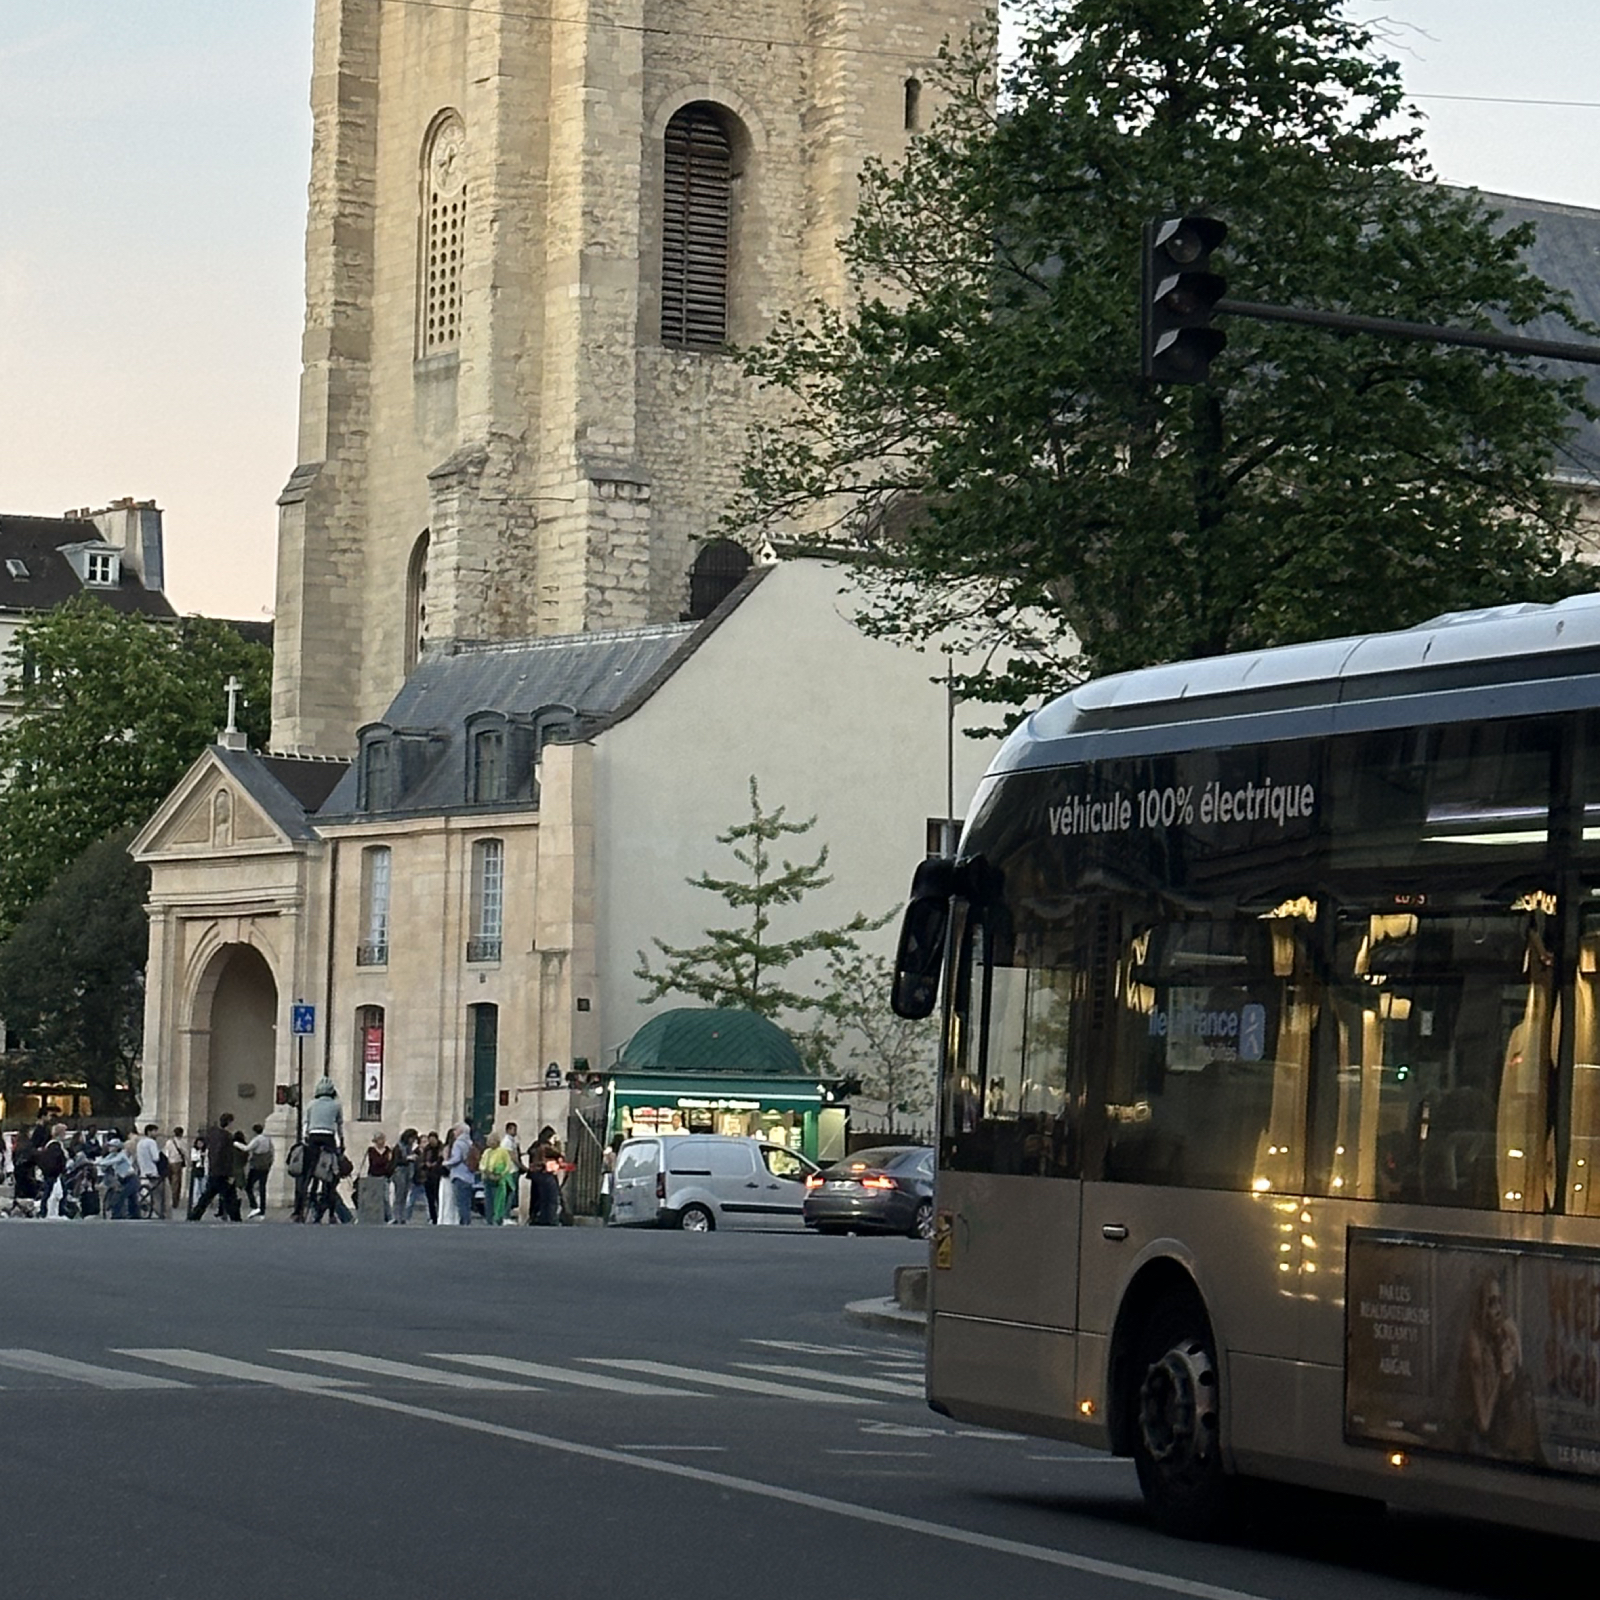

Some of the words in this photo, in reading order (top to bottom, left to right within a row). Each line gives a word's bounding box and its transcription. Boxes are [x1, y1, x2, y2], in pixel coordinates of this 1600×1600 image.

[1049, 792, 1132, 835] véhicule
[1138, 785, 1194, 828] 100%
[1201, 777, 1315, 827] électrique
